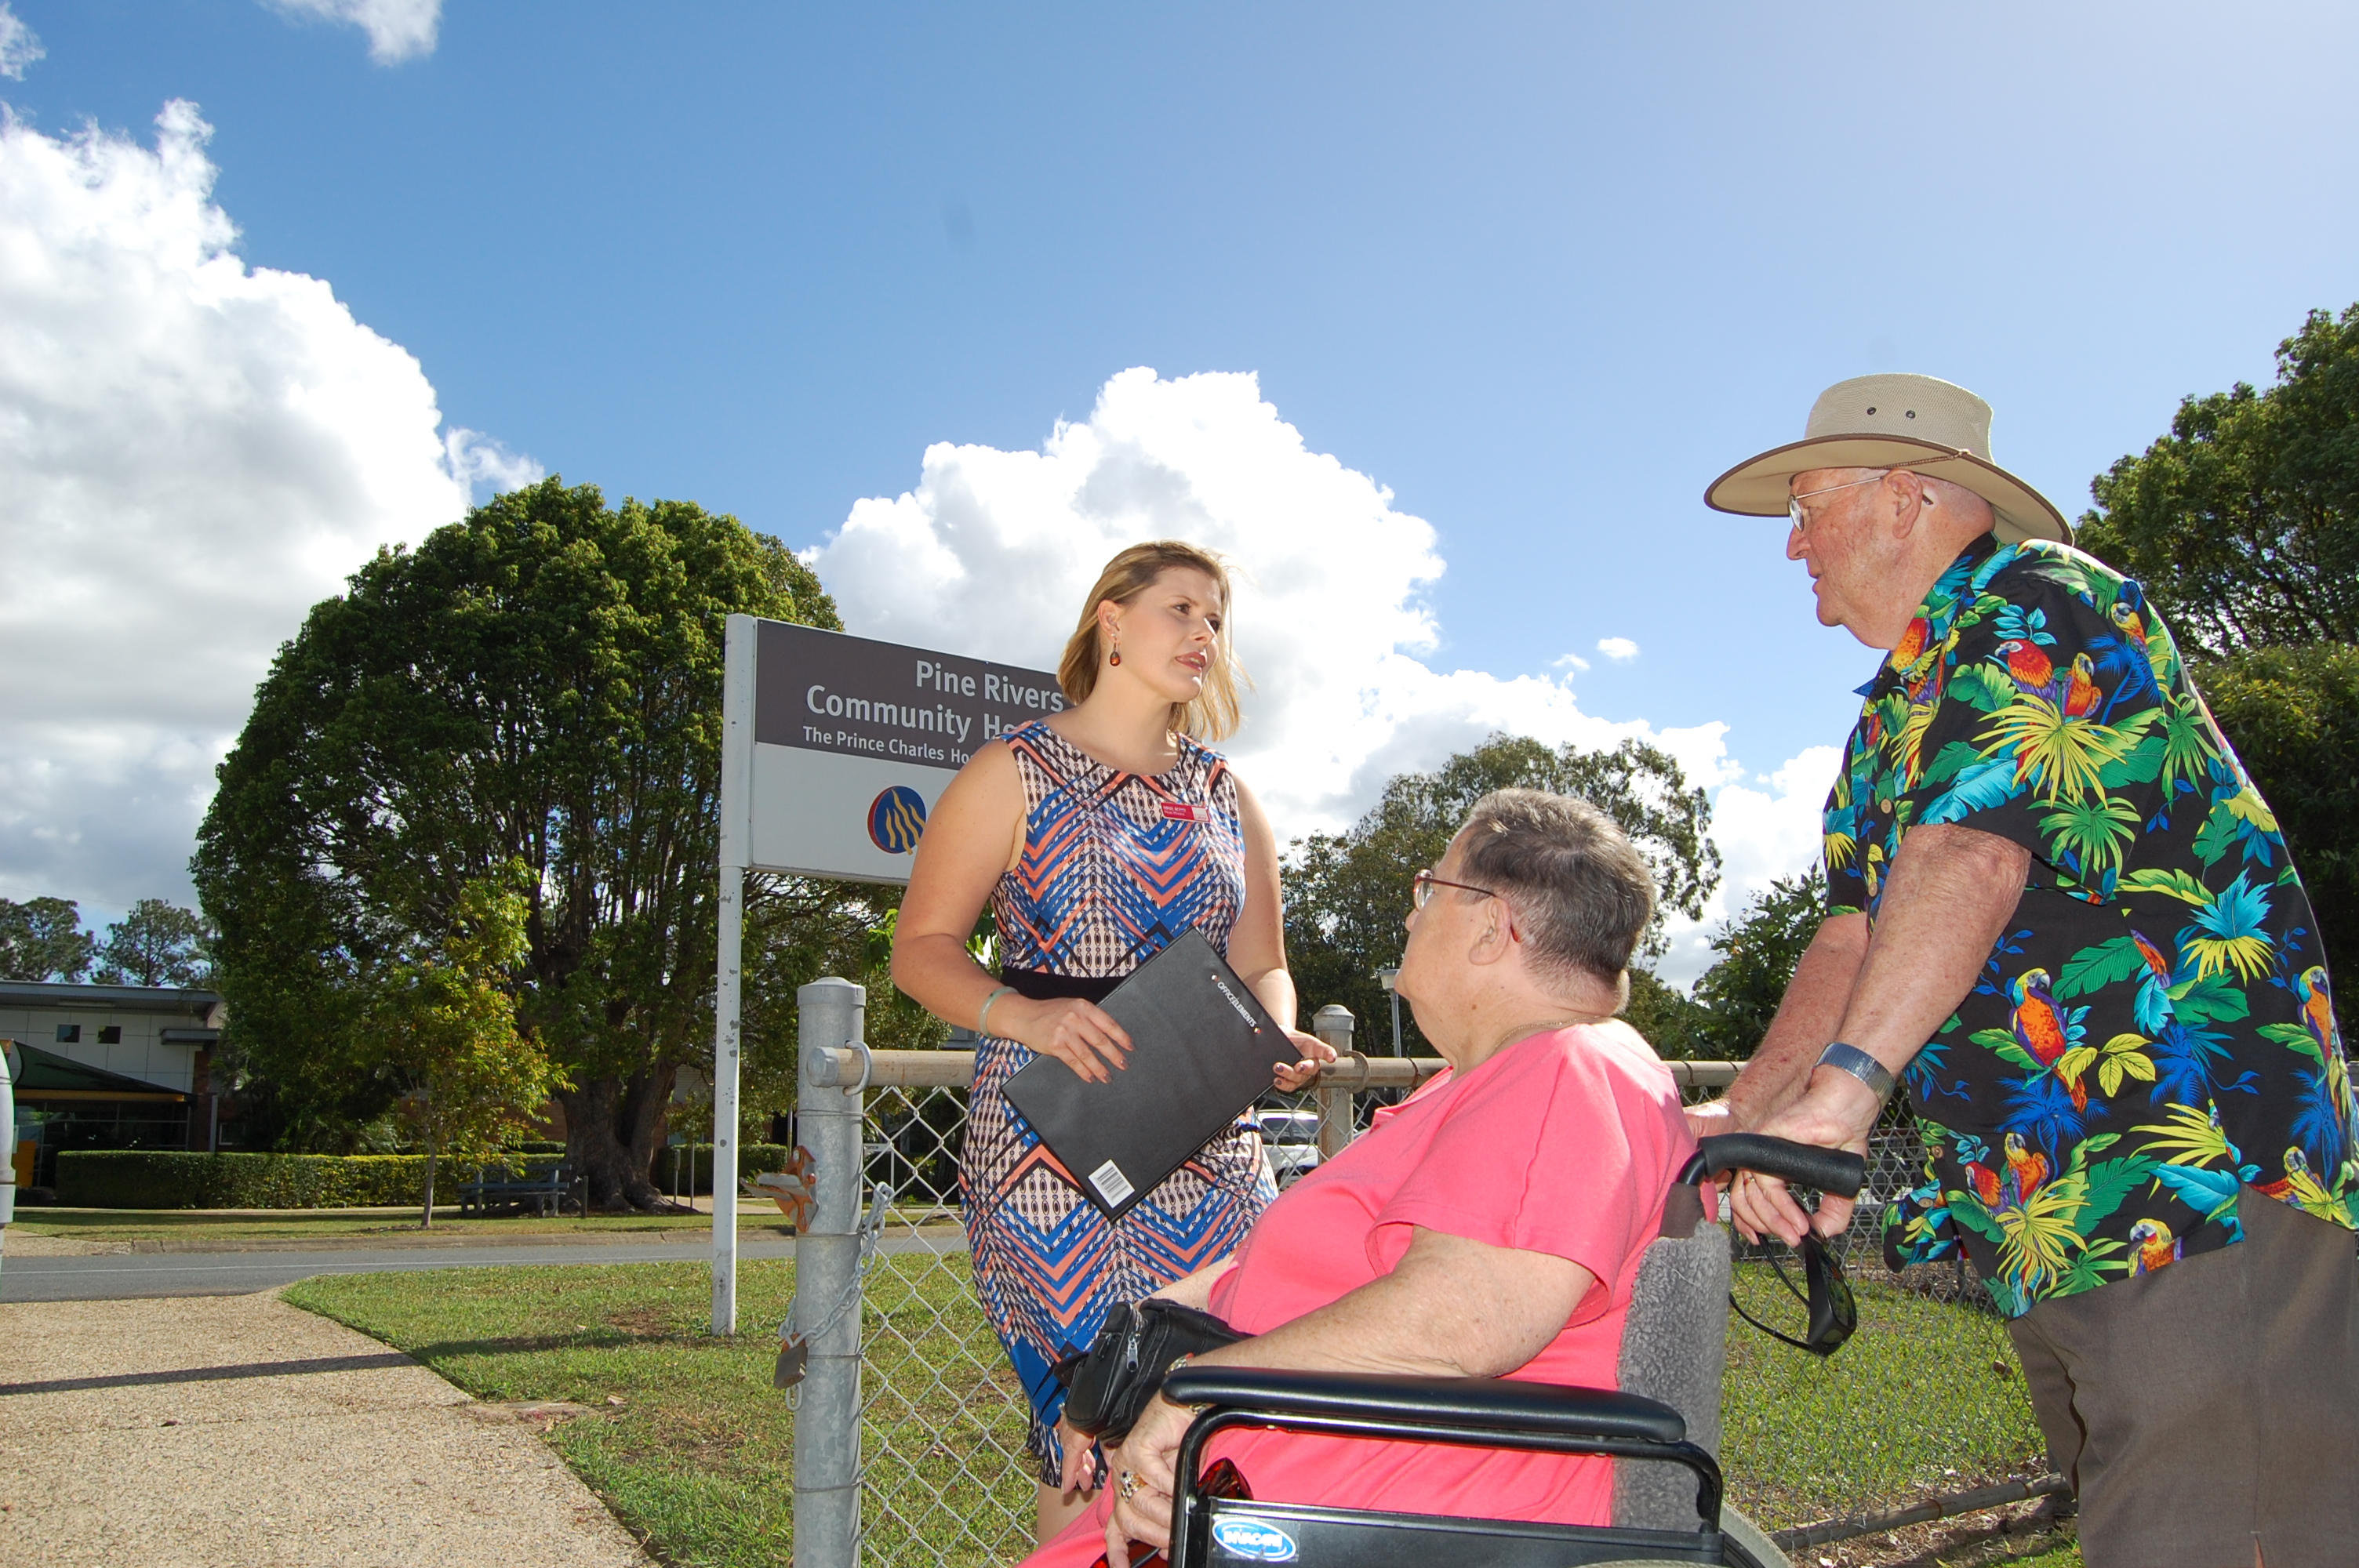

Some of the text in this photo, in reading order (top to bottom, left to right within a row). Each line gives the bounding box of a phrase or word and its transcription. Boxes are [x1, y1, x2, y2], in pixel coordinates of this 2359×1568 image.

[917, 659, 1064, 713] Pine Rivers
[807, 684, 972, 743] Community
[802, 725, 832, 745] The
[837, 730, 885, 752] Prince
[889, 739, 944, 760] Charles
